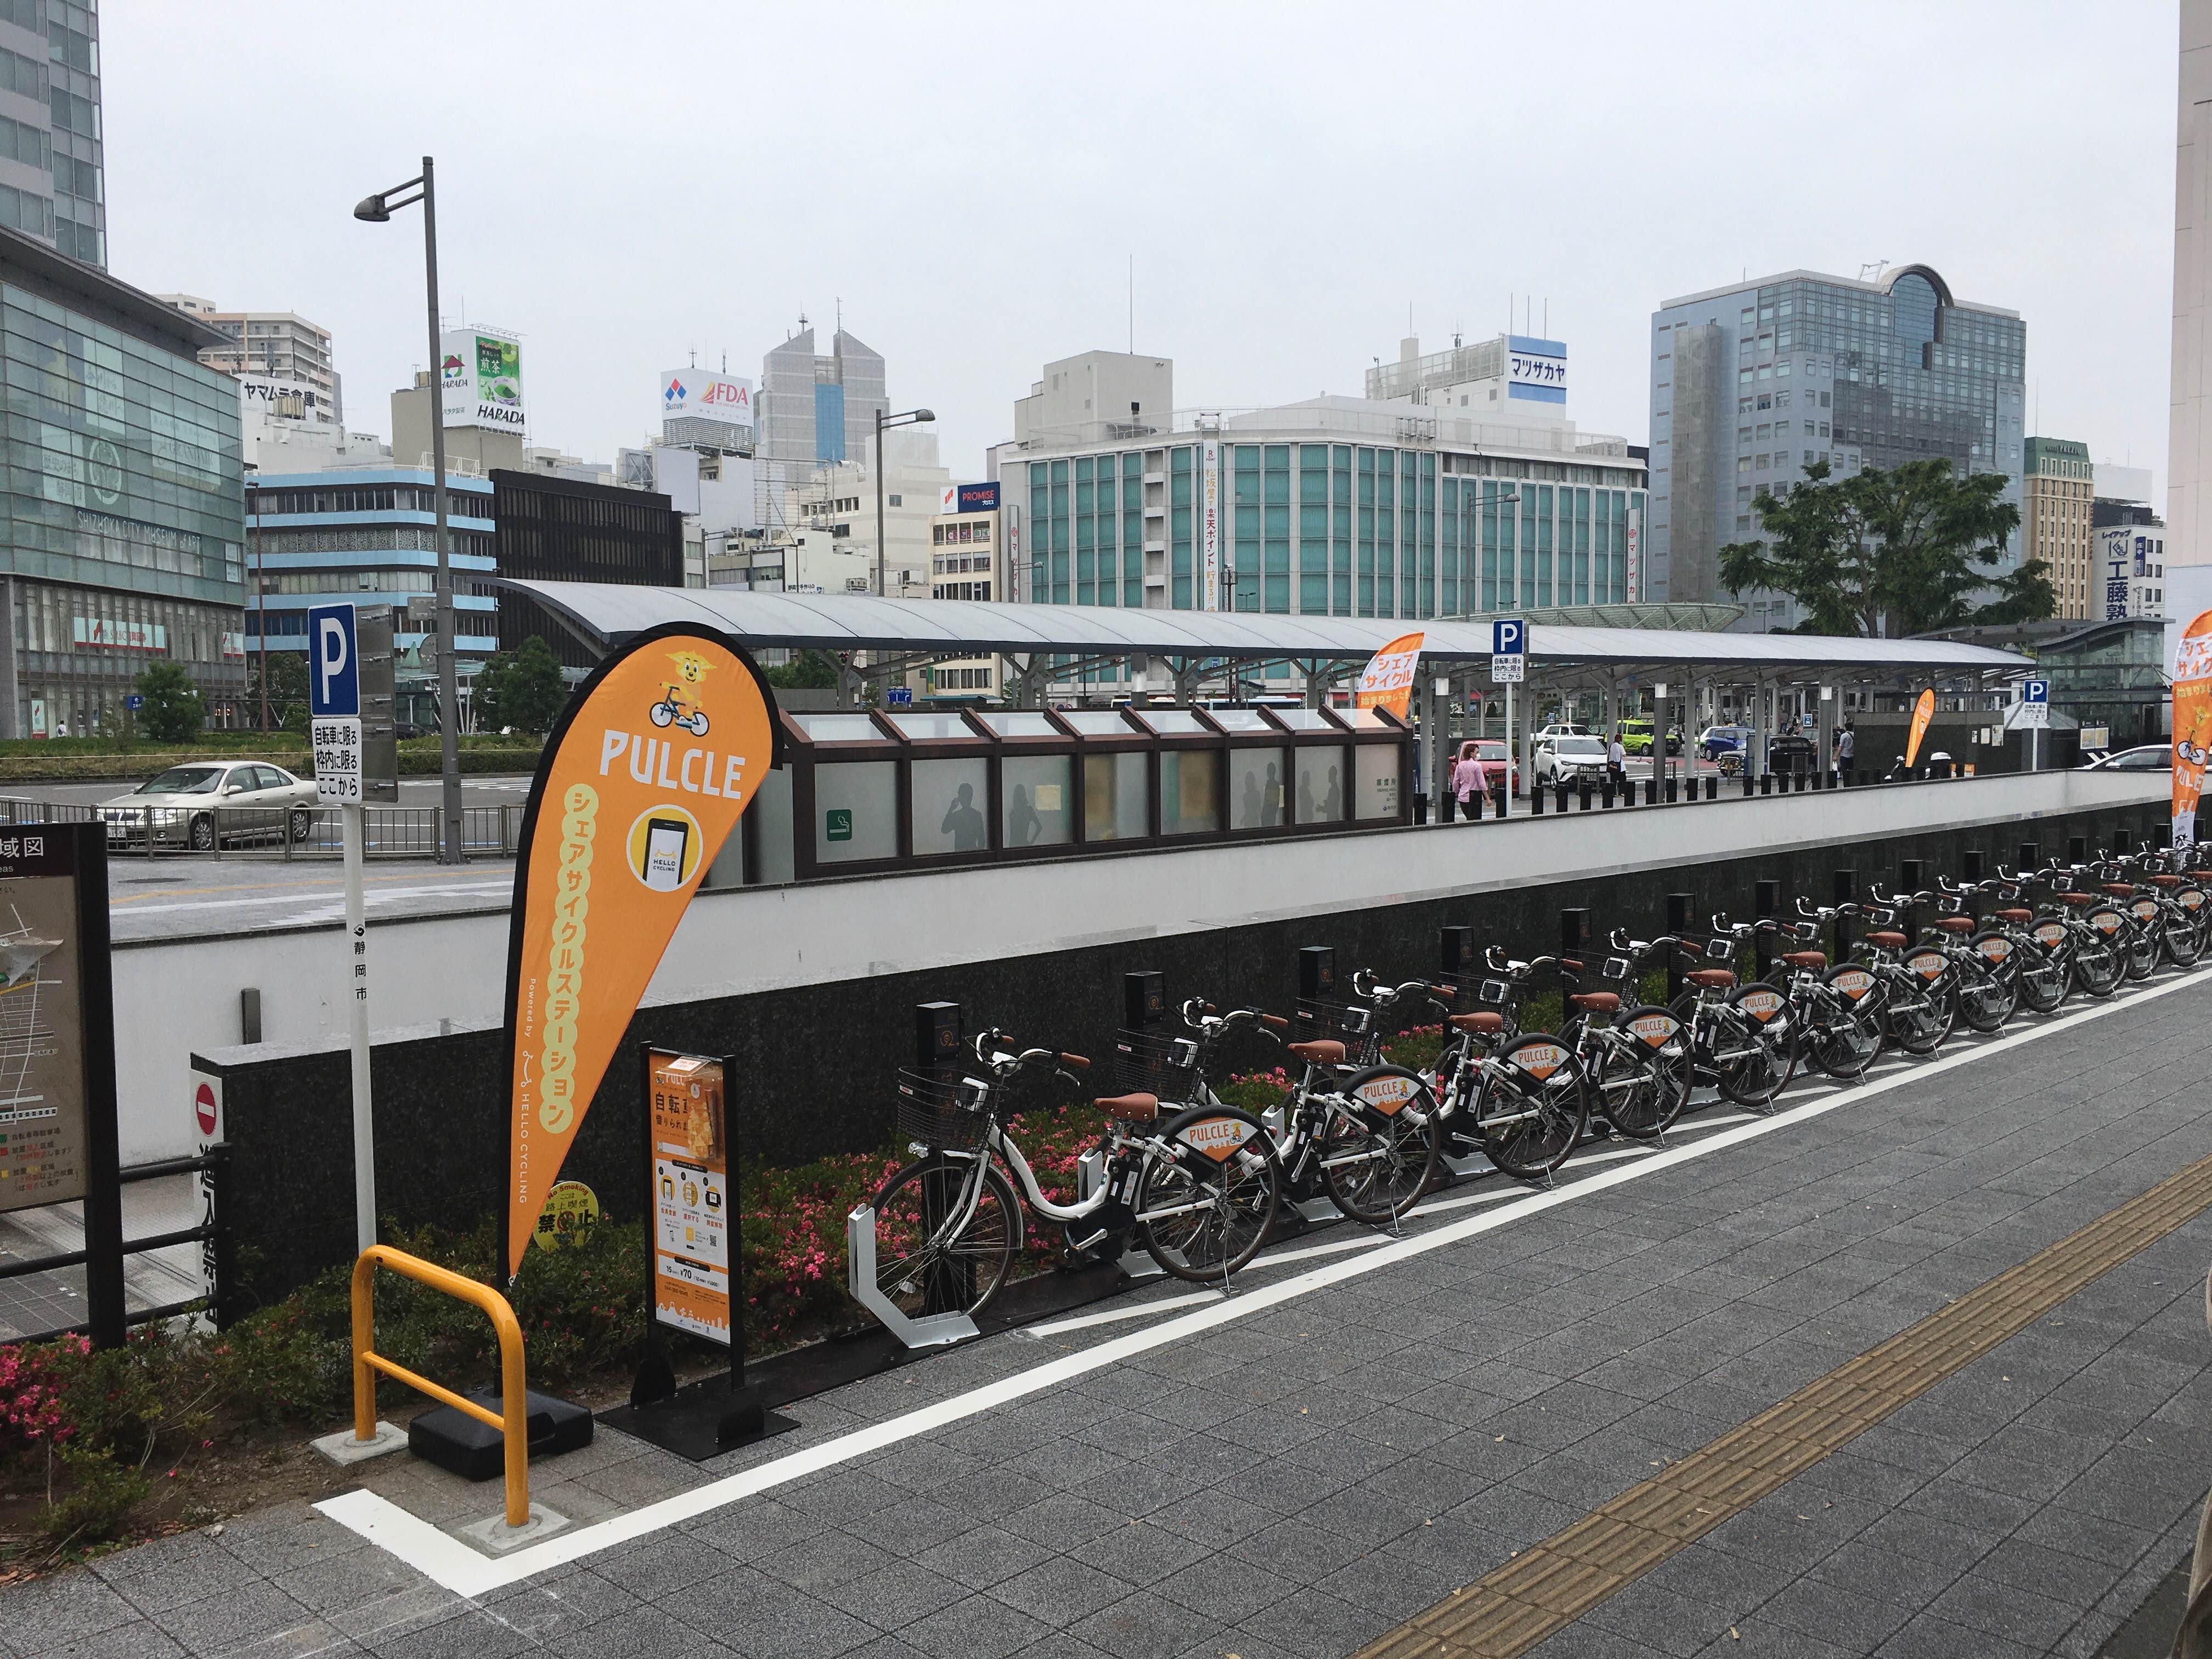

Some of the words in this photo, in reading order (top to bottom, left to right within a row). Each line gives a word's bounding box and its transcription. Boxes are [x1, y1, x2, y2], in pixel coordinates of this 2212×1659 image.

[1511, 358, 1565, 382] マツザカヤ
[716, 382, 749, 405] FDA
[477, 405, 525, 425] HARADA
[665, 403, 687, 411] Suzuyo
[962, 490, 995, 502] PROMISE
[122, 520, 141, 540] CITY
[2106, 560, 2129, 621] 工藤塾
[1500, 623, 1518, 652] P
[2185, 635, 2212, 657] シェ
[320, 617, 347, 704] P
[1378, 653, 1414, 672] シェア
[1365, 669, 1412, 689] サイクル
[2030, 682, 2044, 701] P
[314, 725, 357, 746] 自転車に限る
[315, 749, 357, 770] 枠内に限る
[599, 729, 746, 800] PULCLE
[319, 777, 358, 797] ここから
[1982, 942, 2002, 952] PULCLE
[548, 792, 591, 1126] シェアサイクルステーション
[1914, 956, 1936, 968] PULCLE
[353, 940, 367, 1001] 静岡市
[1837, 975, 1861, 988] PULCLE
[526, 978, 537, 1022] Powered
[1745, 995, 1770, 1008] PULCLE
[524, 1025, 533, 1038] by
[1634, 1019, 1662, 1033] PULCLE
[1518, 1048, 1549, 1063] PULCLE
[1363, 1081, 1398, 1099] PULCLE
[521, 1093, 531, 1139] HELLO
[1189, 1124, 1229, 1143] PULCLE
[518, 1143, 529, 1204] CYCLING
[548, 1190, 558, 1200] No
[559, 1183, 589, 1197] Smoking
[545, 1198, 589, 1212] 路上喫煙
